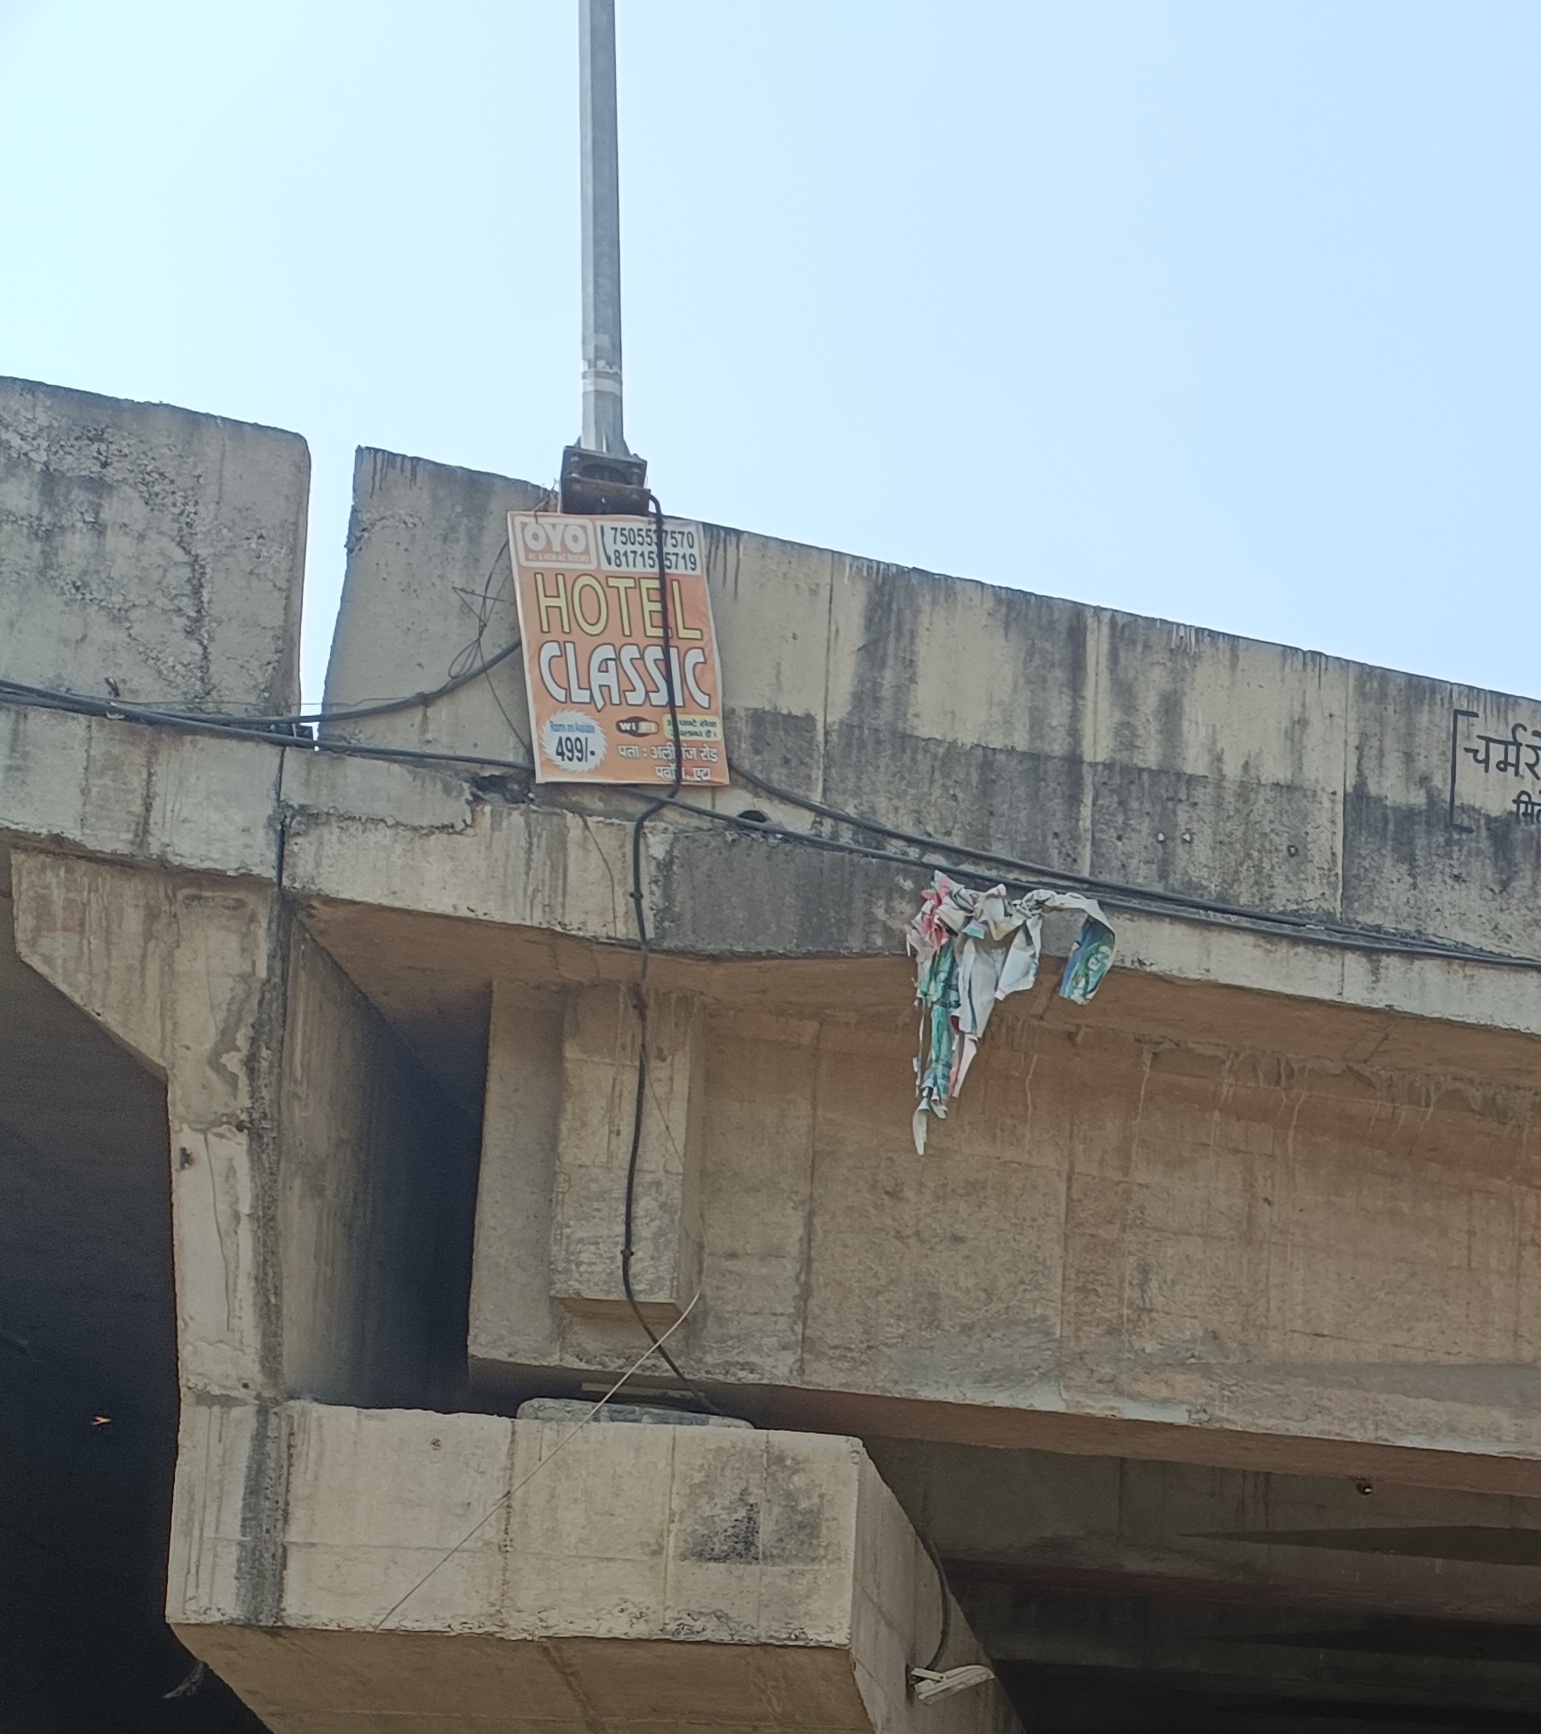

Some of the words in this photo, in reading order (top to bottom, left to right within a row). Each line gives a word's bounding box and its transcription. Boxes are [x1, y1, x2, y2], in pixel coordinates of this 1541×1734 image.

[524, 521, 588, 553] OYO
[533, 571, 703, 640] HOTEL
[538, 640, 711, 713] CLASSIC
[555, 736, 596, 763] 499/-
